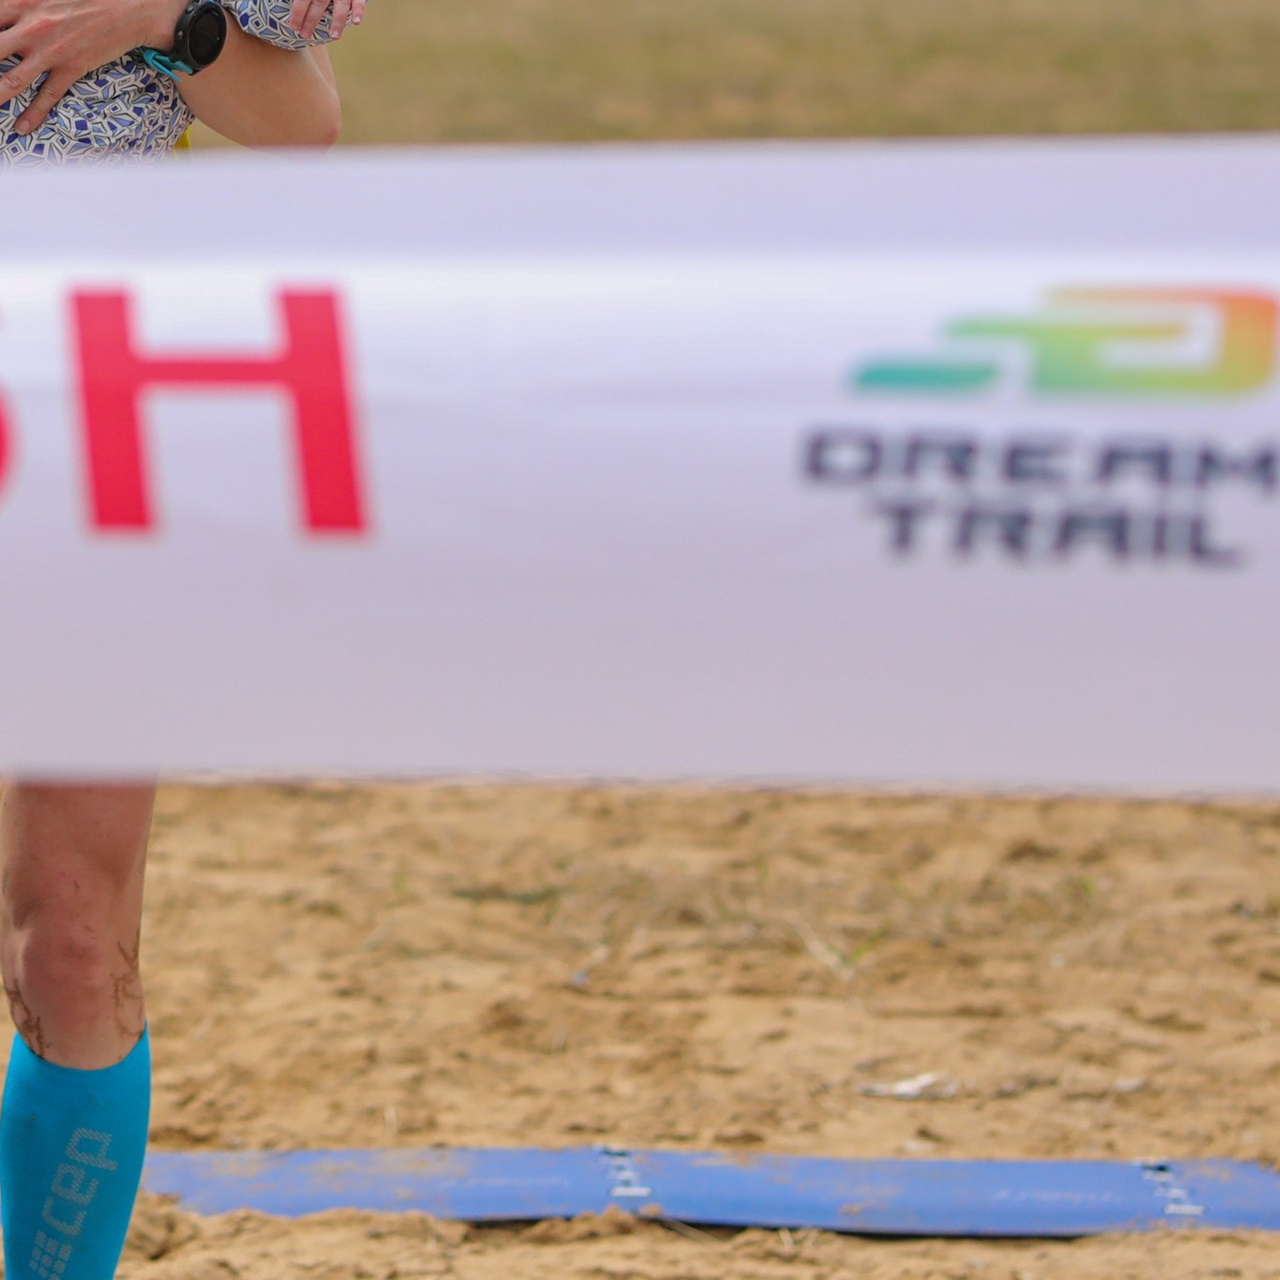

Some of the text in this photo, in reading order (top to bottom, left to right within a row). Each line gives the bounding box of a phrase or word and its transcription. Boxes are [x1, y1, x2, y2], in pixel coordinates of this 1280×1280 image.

[801, 425, 1280, 496] DREAM
[868, 493, 1250, 570] TRAIL
[41, 1126, 119, 1237] cep
